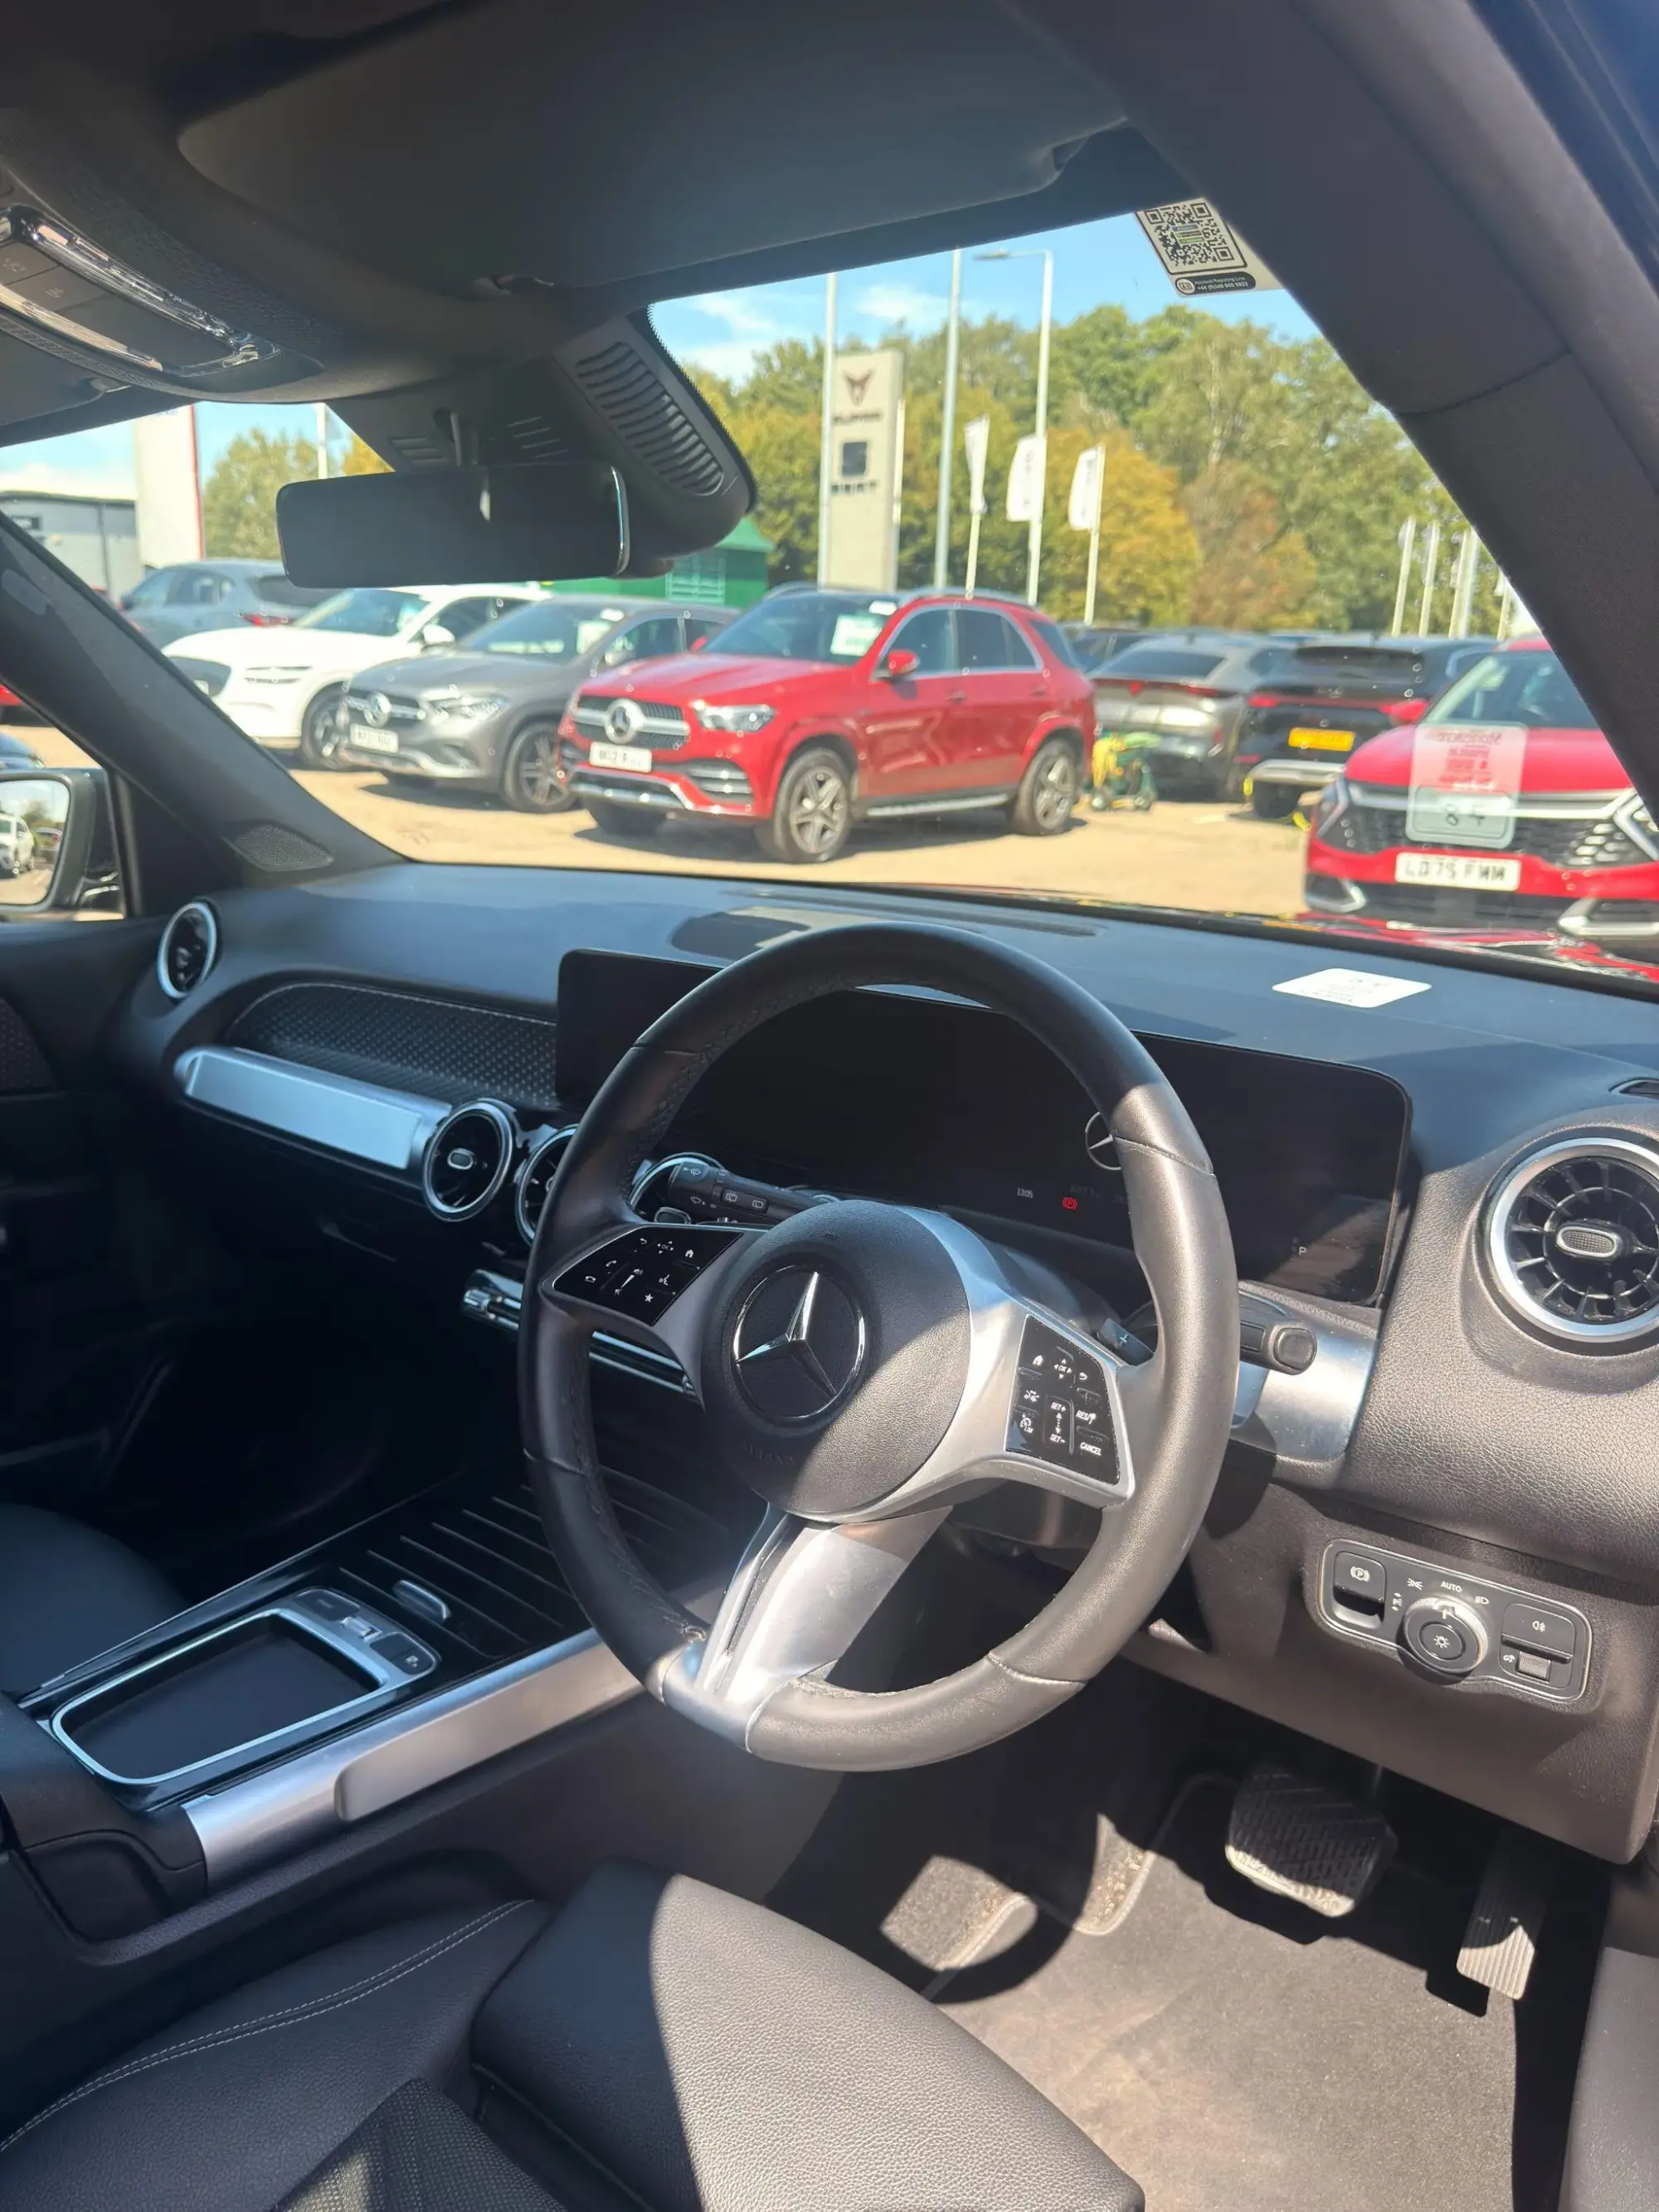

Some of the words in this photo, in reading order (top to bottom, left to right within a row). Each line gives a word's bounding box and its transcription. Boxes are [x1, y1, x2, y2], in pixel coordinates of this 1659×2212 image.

[1298, 1246, 1306, 1255] P
[1058, 1365, 1068, 1373] OK
[1080, 1442, 1102, 1455] CANCEL
[1440, 1581, 1463, 1593] AUTO
